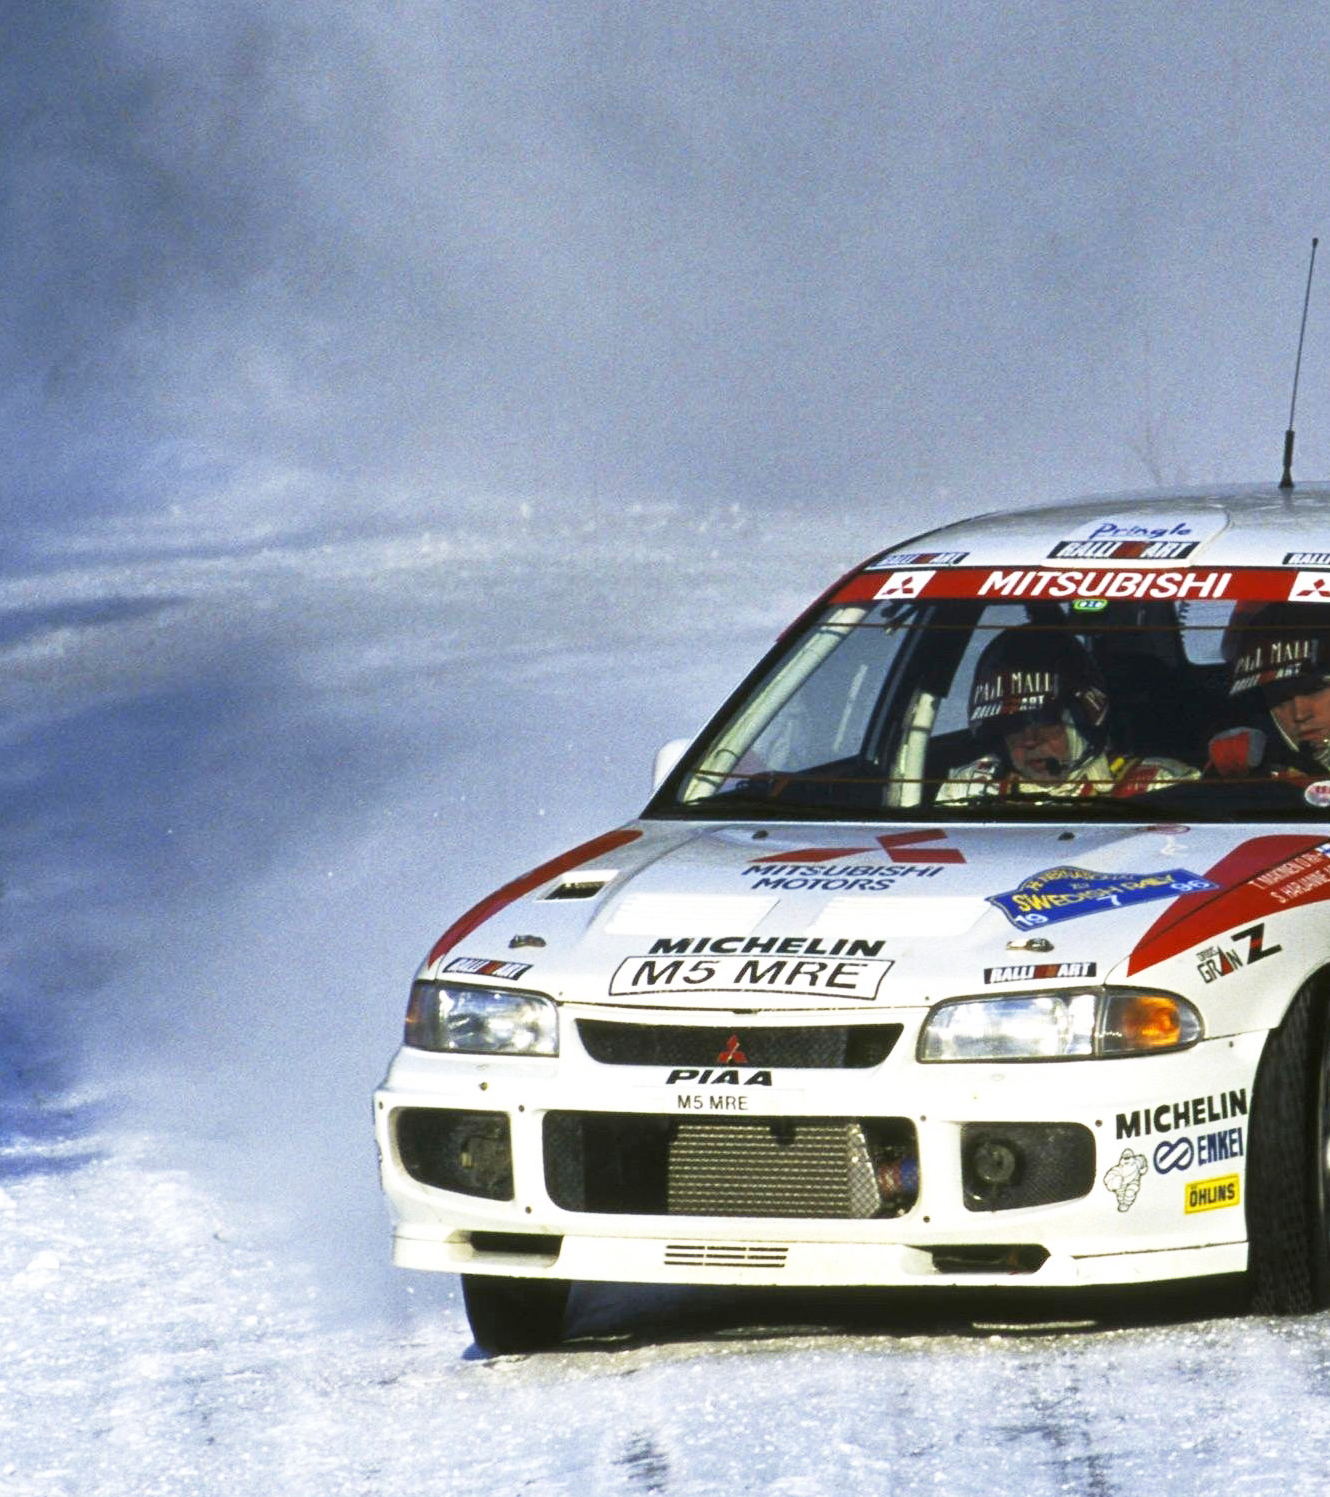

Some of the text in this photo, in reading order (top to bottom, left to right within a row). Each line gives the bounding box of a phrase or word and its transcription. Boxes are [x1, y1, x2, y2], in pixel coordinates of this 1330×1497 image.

[1089, 522, 1192, 539] Pringle
[977, 570, 1232, 599] MITSUBISHI
[741, 865, 945, 877] MITSUBISHI
[751, 878, 896, 891] MOTORS
[1170, 879, 1211, 892] 96
[1011, 886, 1124, 912] SWEDISH
[1096, 894, 1123, 907] 7
[1014, 912, 1049, 927] 19
[648, 936, 887, 957] MICHELIN
[1197, 922, 1283, 984] GRAN Z
[631, 960, 869, 989] M5 MRE
[665, 1069, 773, 1087] PIAA
[677, 1094, 749, 1111] M5 MRE
[1115, 1088, 1248, 1140] MICHELIN
[1197, 1127, 1244, 1167] ENKEI
[1189, 1182, 1236, 1208] ÖHLINS
